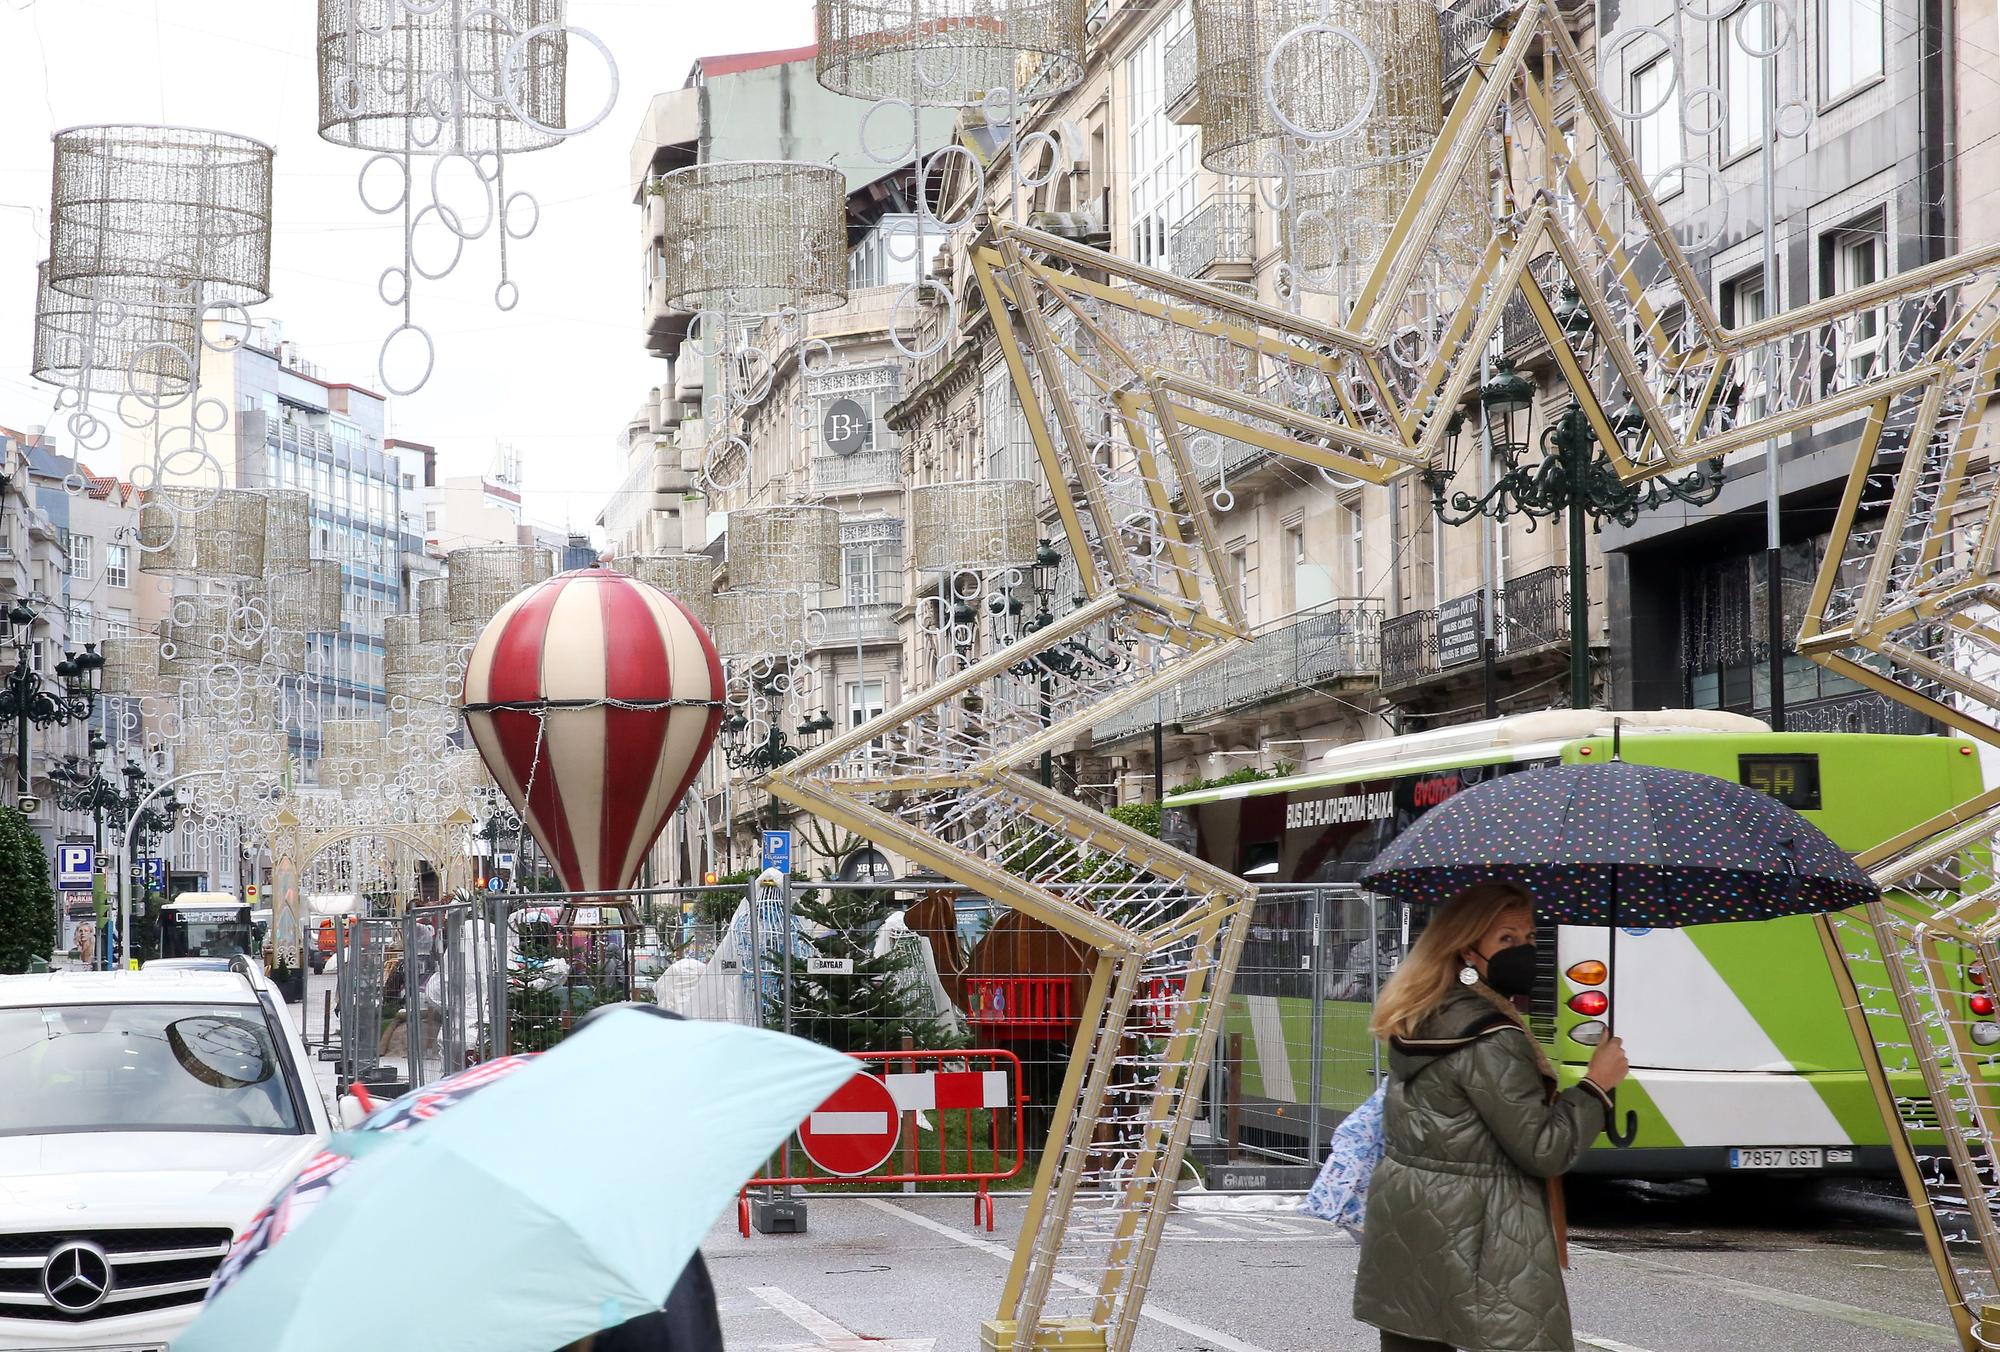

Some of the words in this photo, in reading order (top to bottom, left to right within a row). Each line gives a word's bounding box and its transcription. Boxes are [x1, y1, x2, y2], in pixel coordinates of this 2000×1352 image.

[829, 414, 863, 442] B+
[1286, 803, 1302, 829] BUS
[1303, 800, 1315, 826] DE
[1314, 794, 1366, 825] PLATAFORMA
[1367, 791, 1394, 820] BAIXA
[770, 836, 784, 854] P
[65, 849, 87, 872] P
[69, 895, 93, 904] PARKIN
[819, 961, 843, 969] BAYGAR
[1742, 1151, 1783, 1166] 7857
[1788, 1151, 1819, 1166] GST
